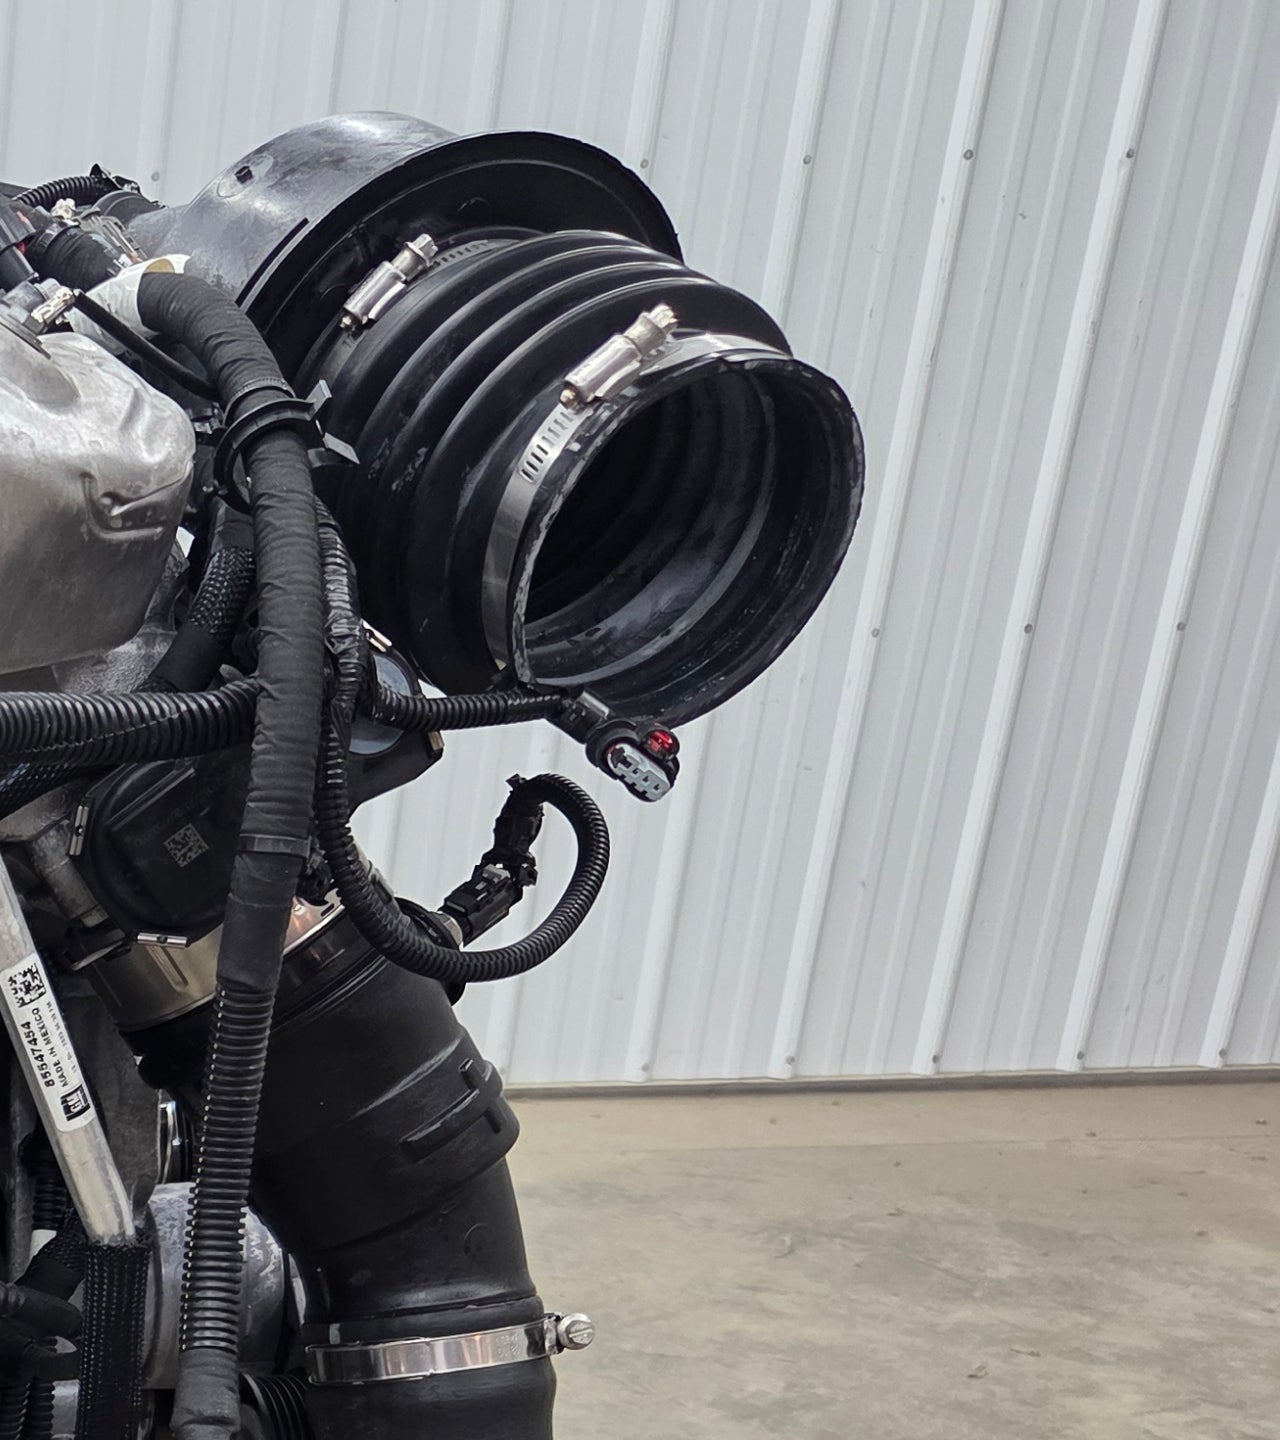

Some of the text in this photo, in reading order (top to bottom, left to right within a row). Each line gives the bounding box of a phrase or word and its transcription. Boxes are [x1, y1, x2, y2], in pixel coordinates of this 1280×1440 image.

[32, 1007, 52, 1046] MEXICO
[21, 1021, 55, 1087] 85547454
[47, 1047, 57, 1057] IN
[53, 1059, 69, 1087] MADE
